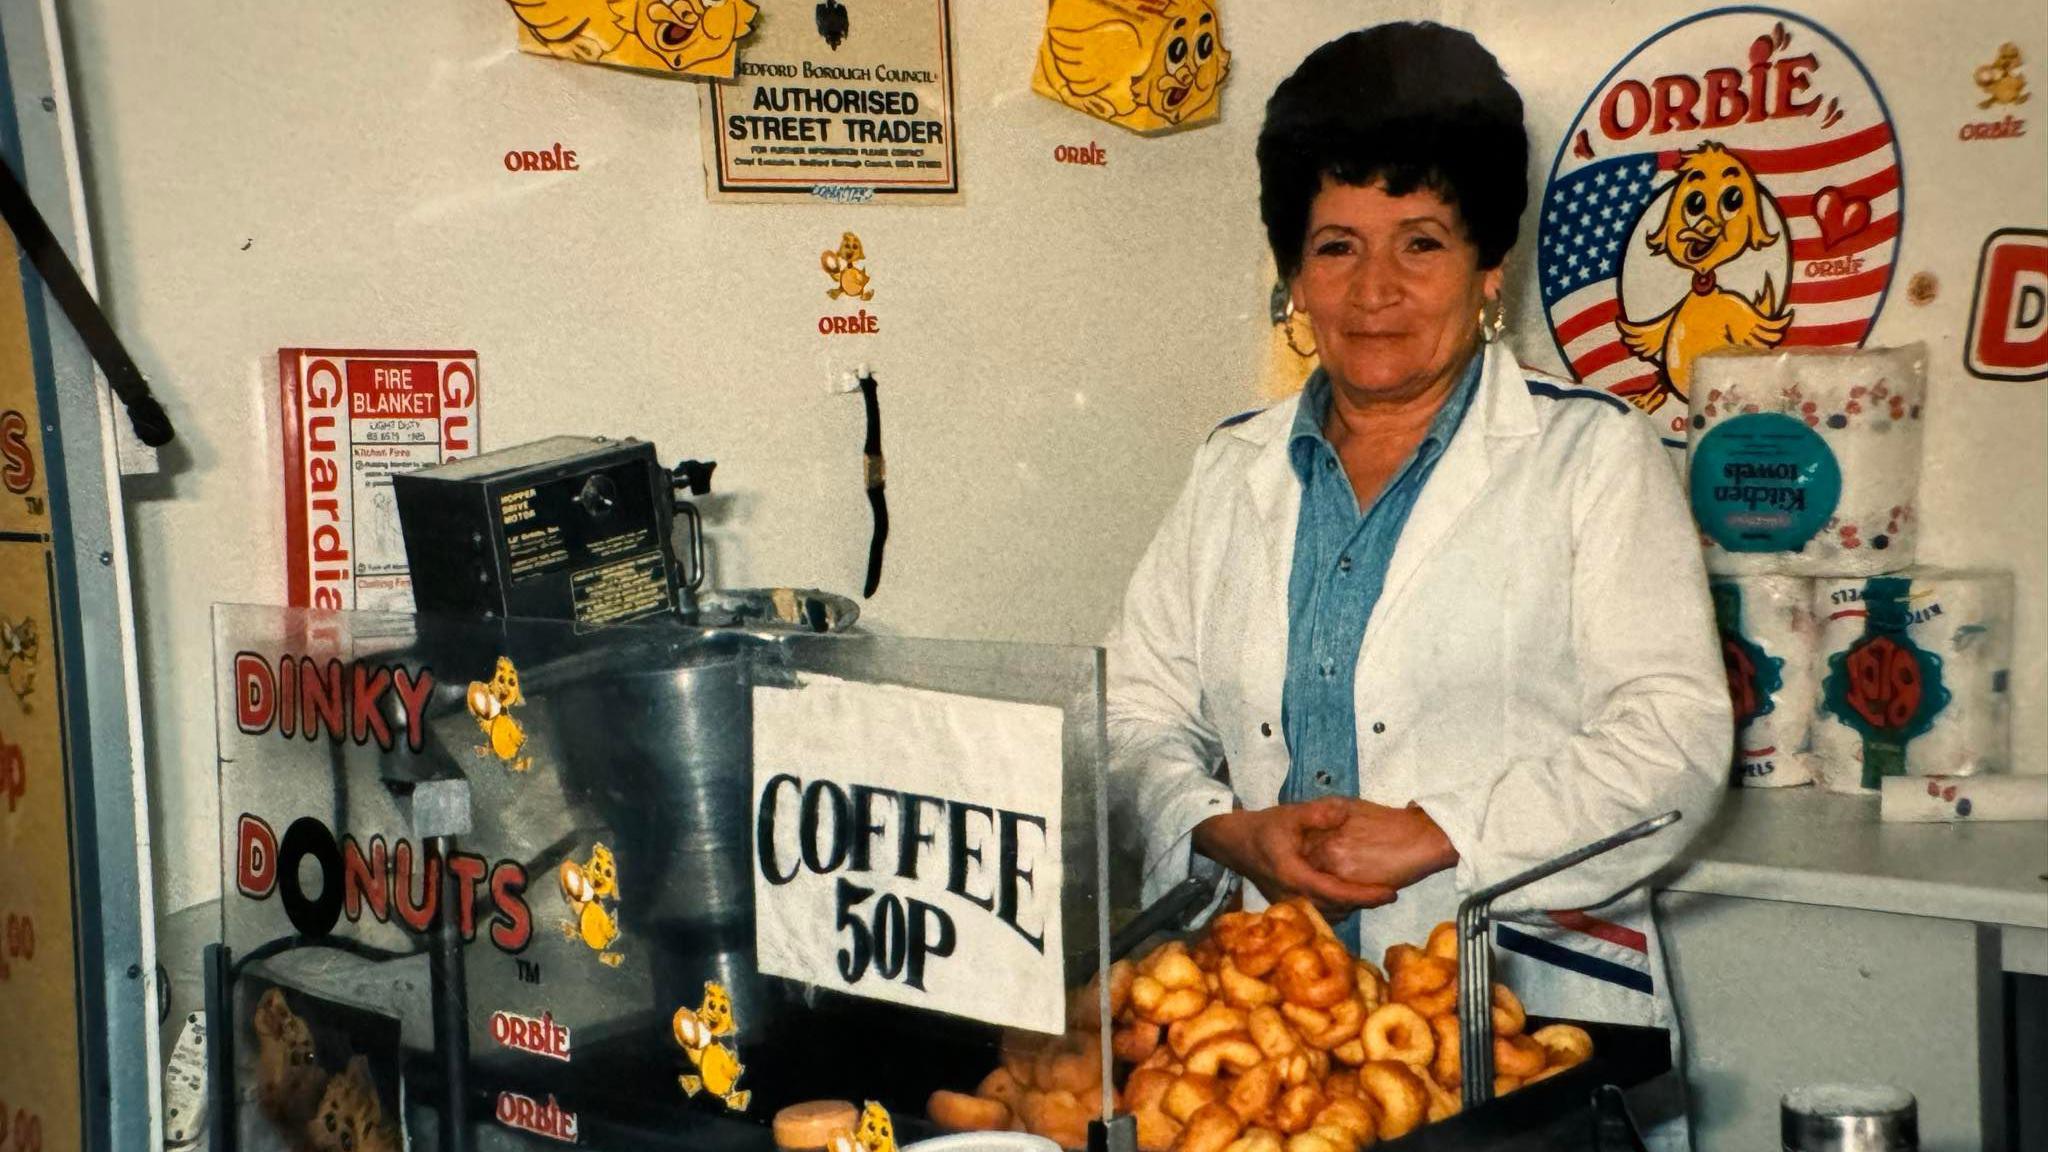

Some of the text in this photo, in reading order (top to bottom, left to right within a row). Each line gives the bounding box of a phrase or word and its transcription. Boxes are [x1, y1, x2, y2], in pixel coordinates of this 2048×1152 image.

[737, 61, 937, 84] EDFORD BOROUGH COUNCIL
[1599, 33, 1823, 141] ORBIE
[753, 86, 919, 115] AUTHORISED
[729, 115, 944, 144] STREET TRADER
[504, 143, 579, 171] ORBIE
[1054, 141, 1108, 166] ORBIE
[818, 309, 880, 334] ORBIE
[374, 368, 413, 389] FIRE
[353, 393, 434, 414] BLANKET
[1714, 486, 1806, 512] Kitchen
[234, 651, 434, 755] DINKY
[757, 773, 1047, 955] COFFEE
[236, 812, 534, 954] DONUTS
[836, 877, 957, 994] 50P
[516, 957, 541, 985] TM
[488, 1010, 572, 1061] ORBIE
[497, 1092, 578, 1142] ORBIE
